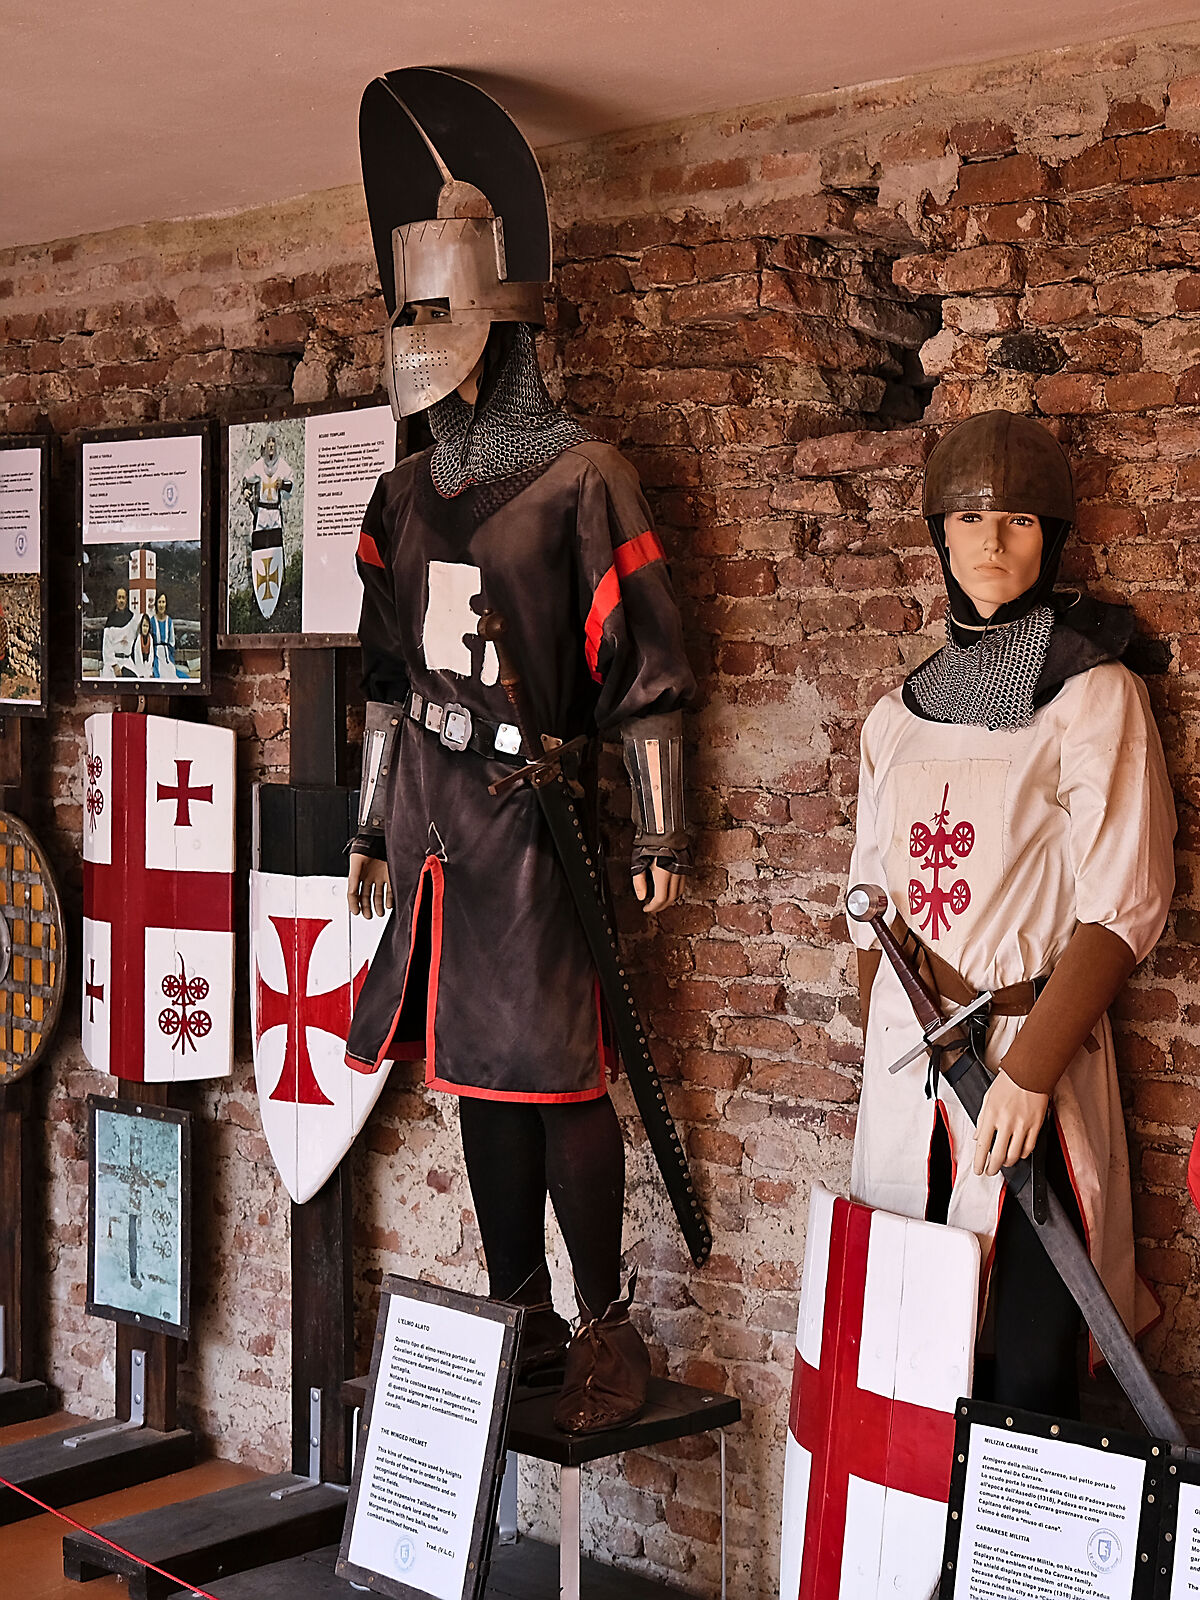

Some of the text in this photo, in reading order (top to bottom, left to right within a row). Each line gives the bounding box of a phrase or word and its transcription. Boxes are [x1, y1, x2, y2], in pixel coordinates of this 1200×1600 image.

[984, 1437, 1038, 1455] MILIZIA CARRARESE
[982, 1455, 1007, 1465] Armigero
[1021, 1465, 1039, 1473] milizia
[1094, 1481, 1109, 1489] porta
[982, 1464, 1003, 1473] stemma
[1021, 1472, 1043, 1483] Carrara.
[988, 1475, 1005, 1483] scudo
[1027, 1484, 1049, 1493] stemma
[1049, 1488, 1063, 1496] della
[1085, 1496, 1106, 1506] Padova
[978, 1498, 1002, 1509] Capitano
[979, 1490, 1000, 1499] comune
[1005, 1496, 1025, 1505] Jacopo
[1033, 1502, 1054, 1512] Carrara
[1055, 1508, 1084, 1519] governava
[1084, 1515, 1100, 1523] come
[1057, 1499, 1077, 1509] Padova
[1088, 1507, 1108, 1516] ancora
[1108, 1511, 1126, 1520] libero
[1000, 1513, 1015, 1521] detto
[975, 1524, 1030, 1543] CARRARESE MILITIA
[973, 1551, 995, 1561] displays
[1005, 1560, 1027, 1569] emblem
[1034, 1566, 1044, 1574] the
[1044, 1568, 1052, 1576] Da
[1052, 1571, 1074, 1581] Carrara
[1074, 1576, 1093, 1587] family.
[970, 1576, 991, 1586] Carrara
[991, 1583, 1005, 1591] ruled
[1015, 1589, 1026, 1597] city
[1188, 1582, 1199, 1591] The
